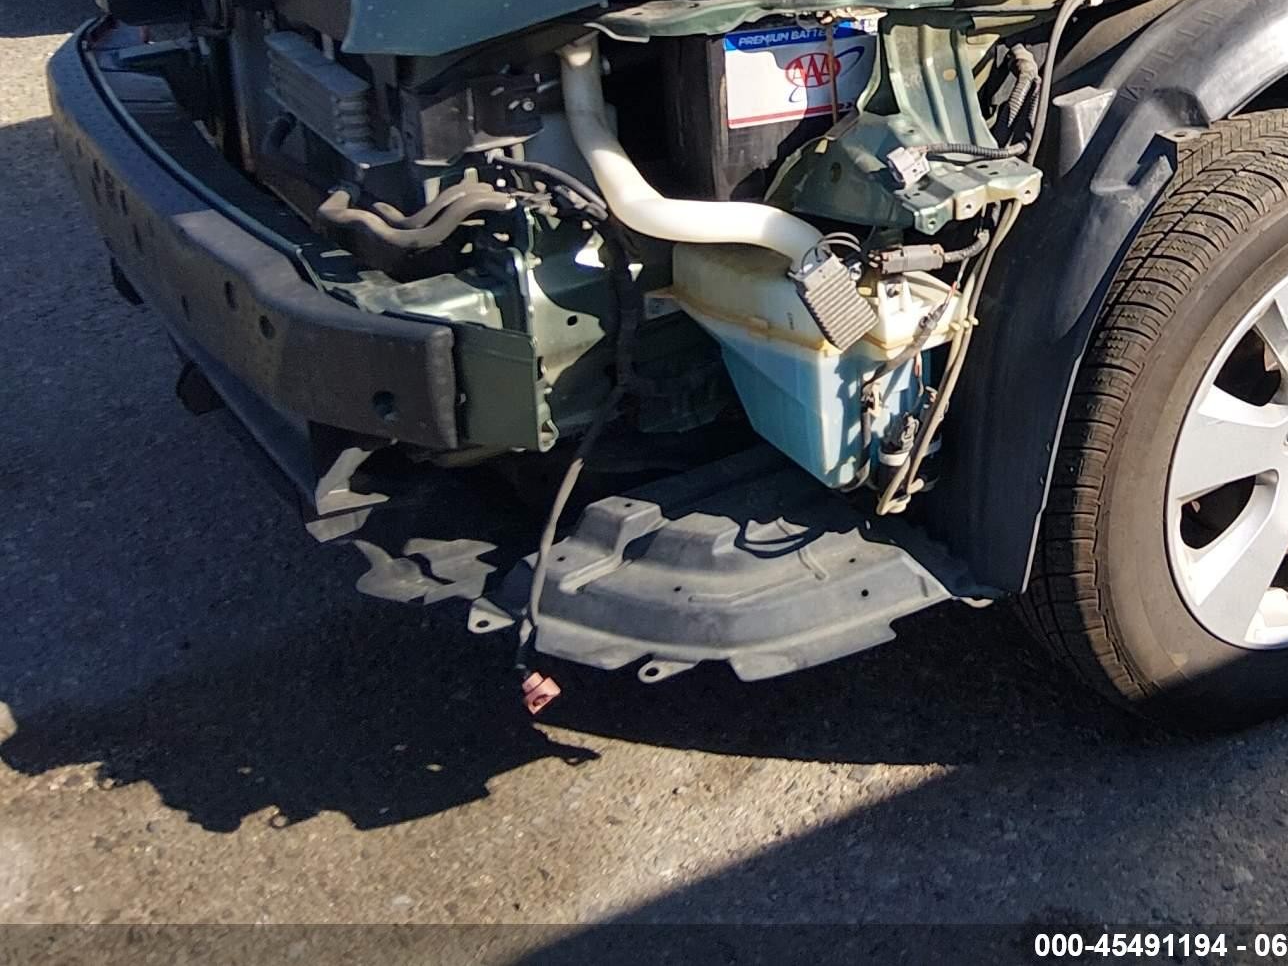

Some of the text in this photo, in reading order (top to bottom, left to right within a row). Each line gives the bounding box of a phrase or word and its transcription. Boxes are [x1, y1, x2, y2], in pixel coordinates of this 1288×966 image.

[739, 26, 838, 46] PREMIUM BATTEY
[792, 54, 836, 87] AAA
